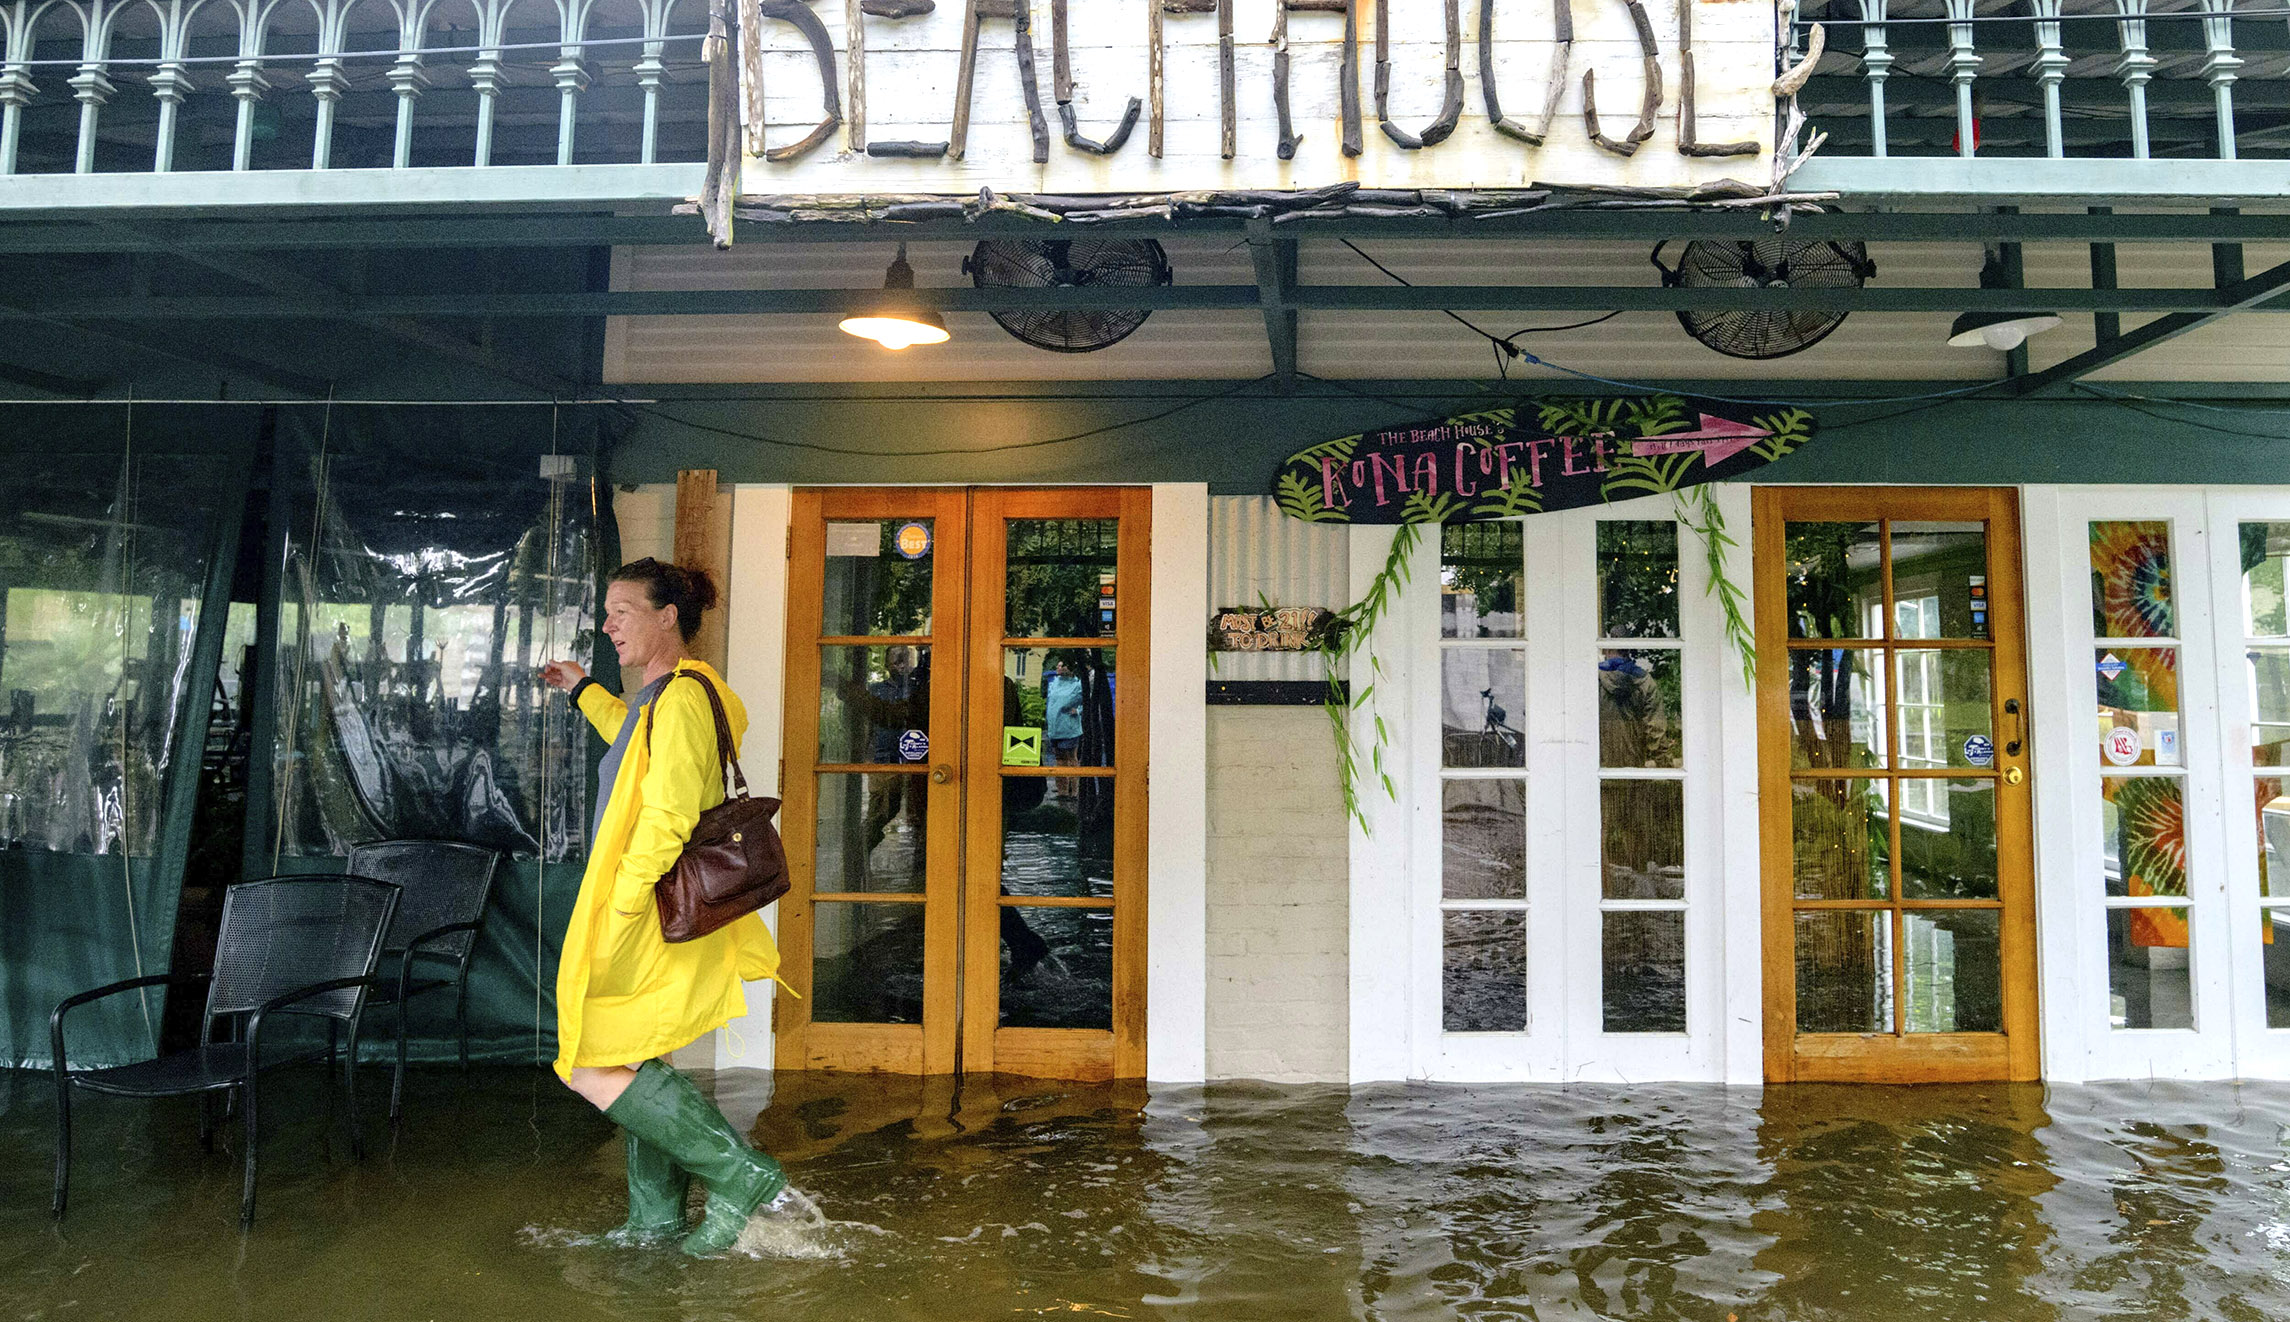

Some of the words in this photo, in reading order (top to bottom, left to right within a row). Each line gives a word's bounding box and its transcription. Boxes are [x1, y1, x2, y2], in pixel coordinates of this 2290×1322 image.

[1377, 431, 1406, 446] THE
[1410, 425, 1450, 443] BEACH
[900, 538, 928, 550] BEST
[1220, 612, 1257, 632] MUST
[1227, 632, 1252, 649] TO
[1256, 631, 1309, 649] DRINK
